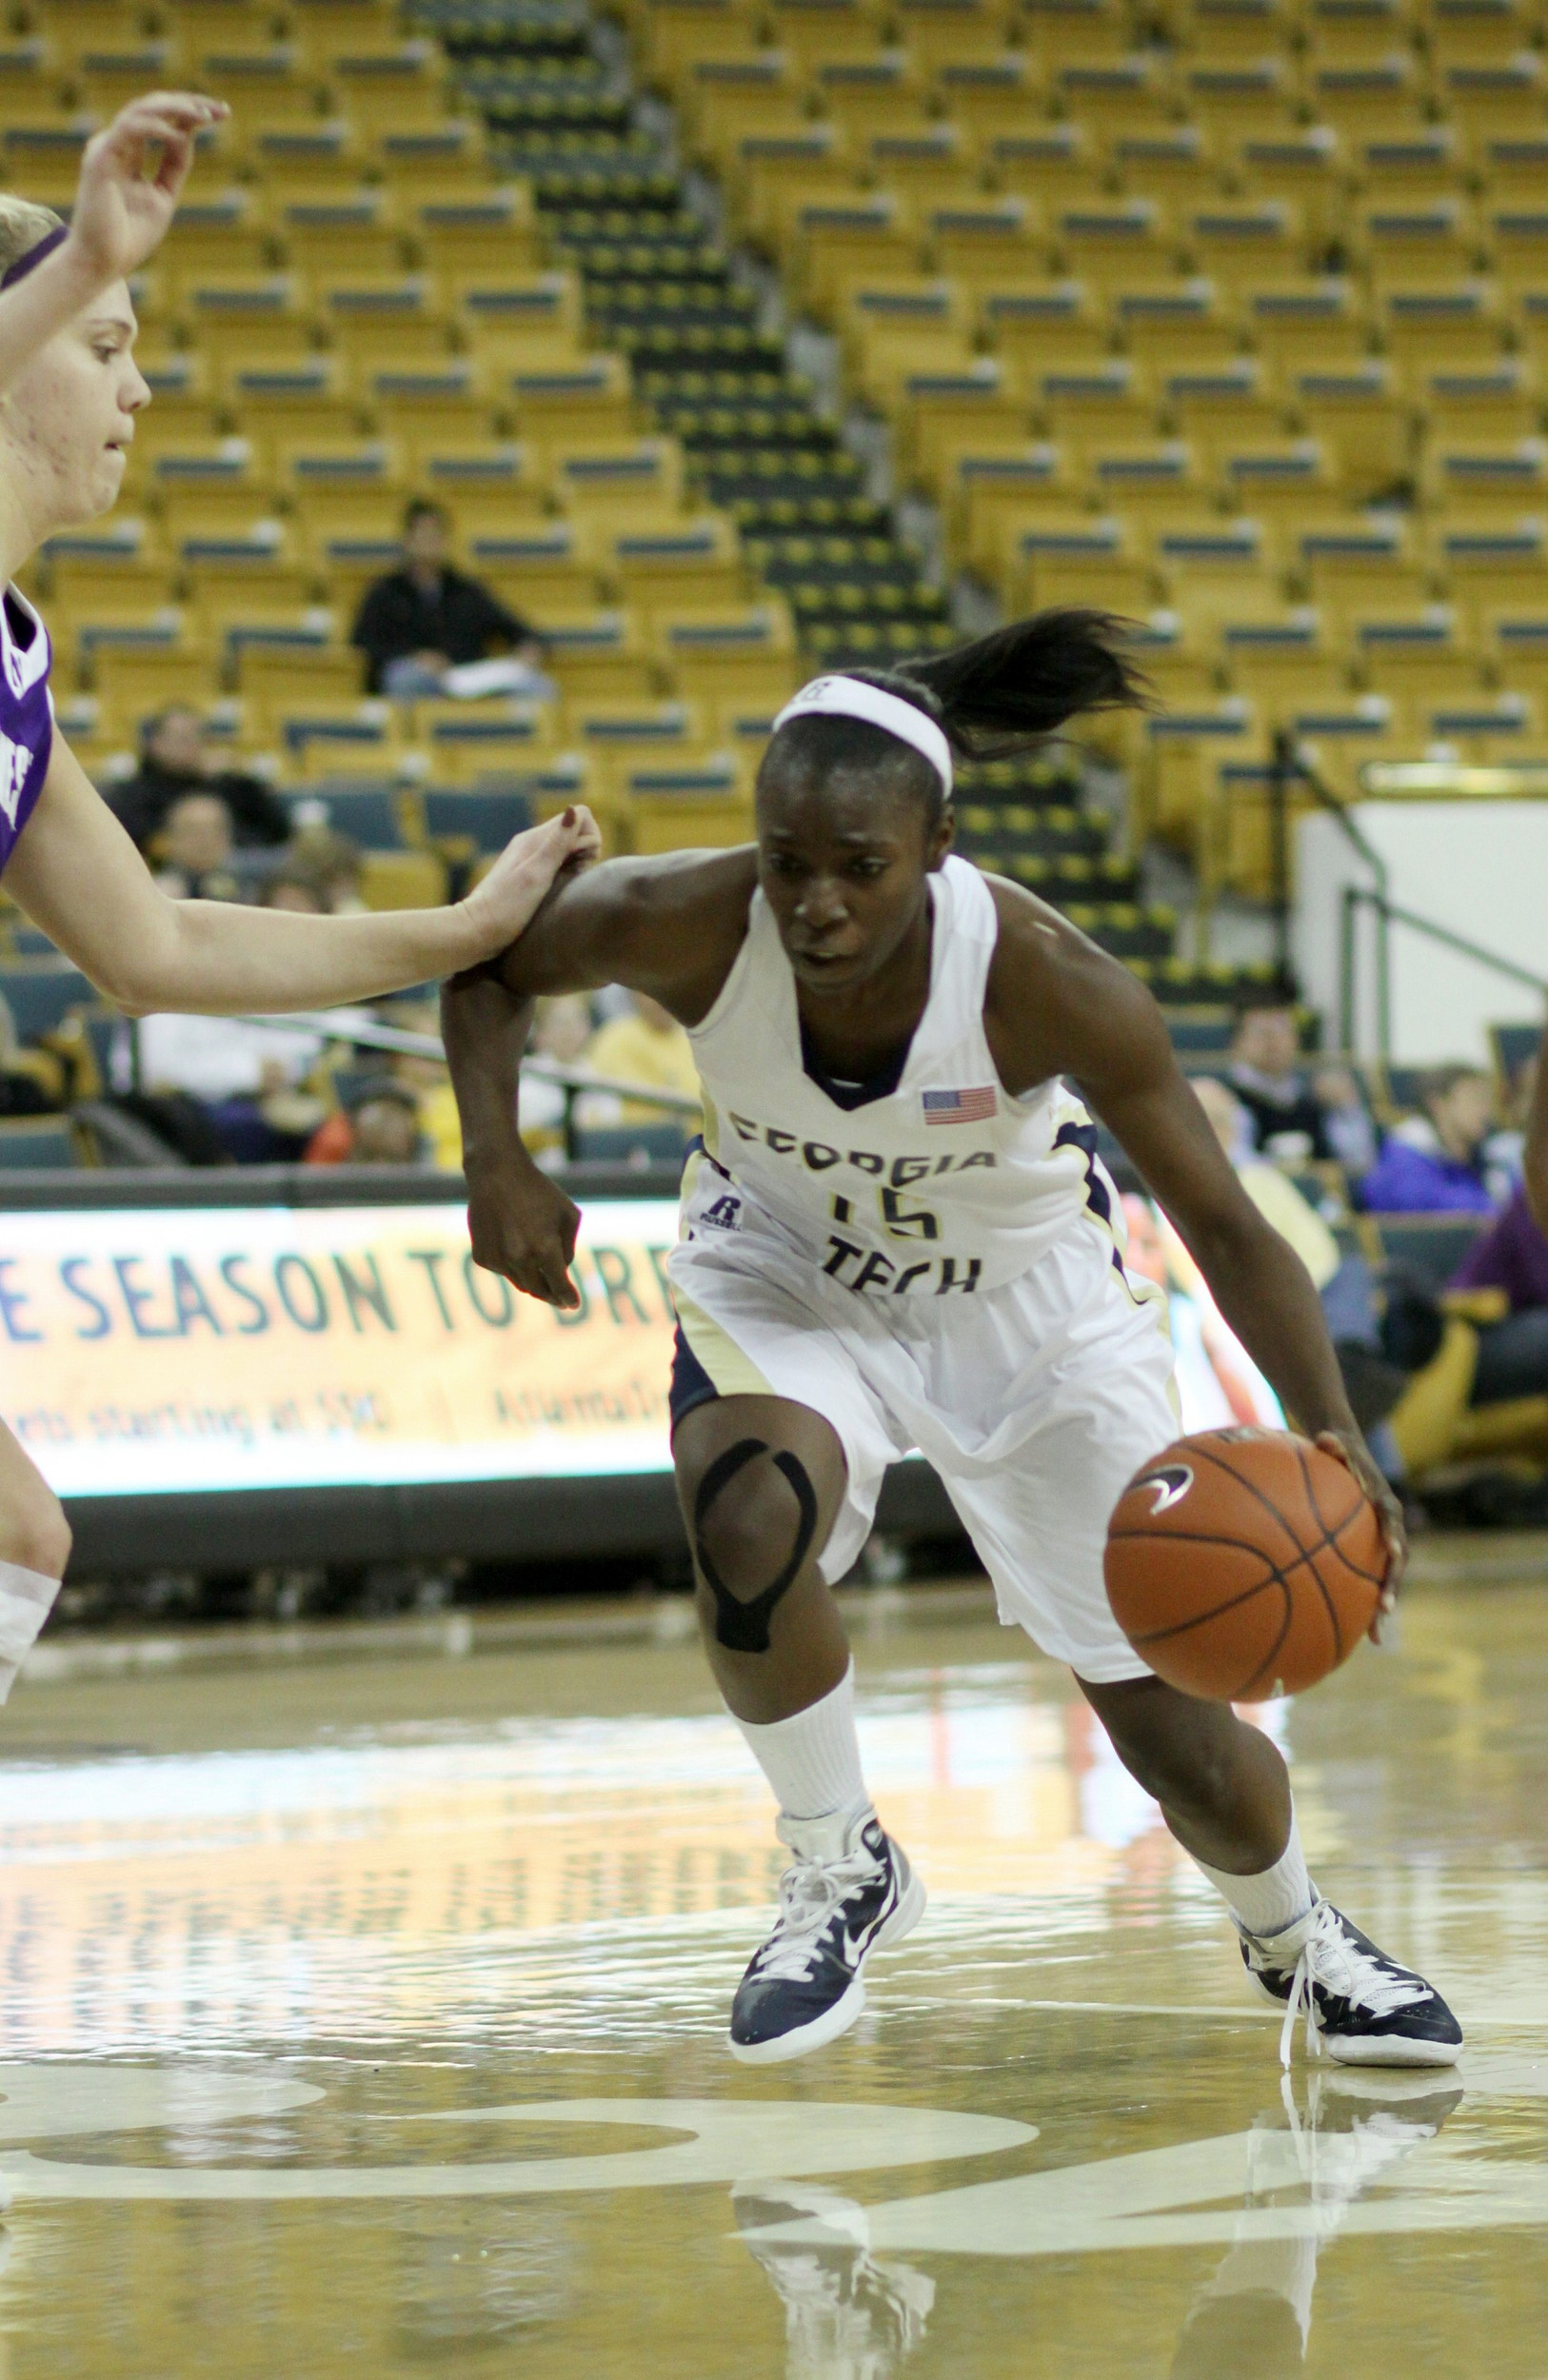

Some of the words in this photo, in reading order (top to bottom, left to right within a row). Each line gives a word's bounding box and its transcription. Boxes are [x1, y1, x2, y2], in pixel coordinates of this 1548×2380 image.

[829, 1185, 943, 1240] 15
[823, 1234, 982, 1294] TECH
[58, 1250, 400, 1340] SEASON
[406, 1249, 514, 1332] TO
